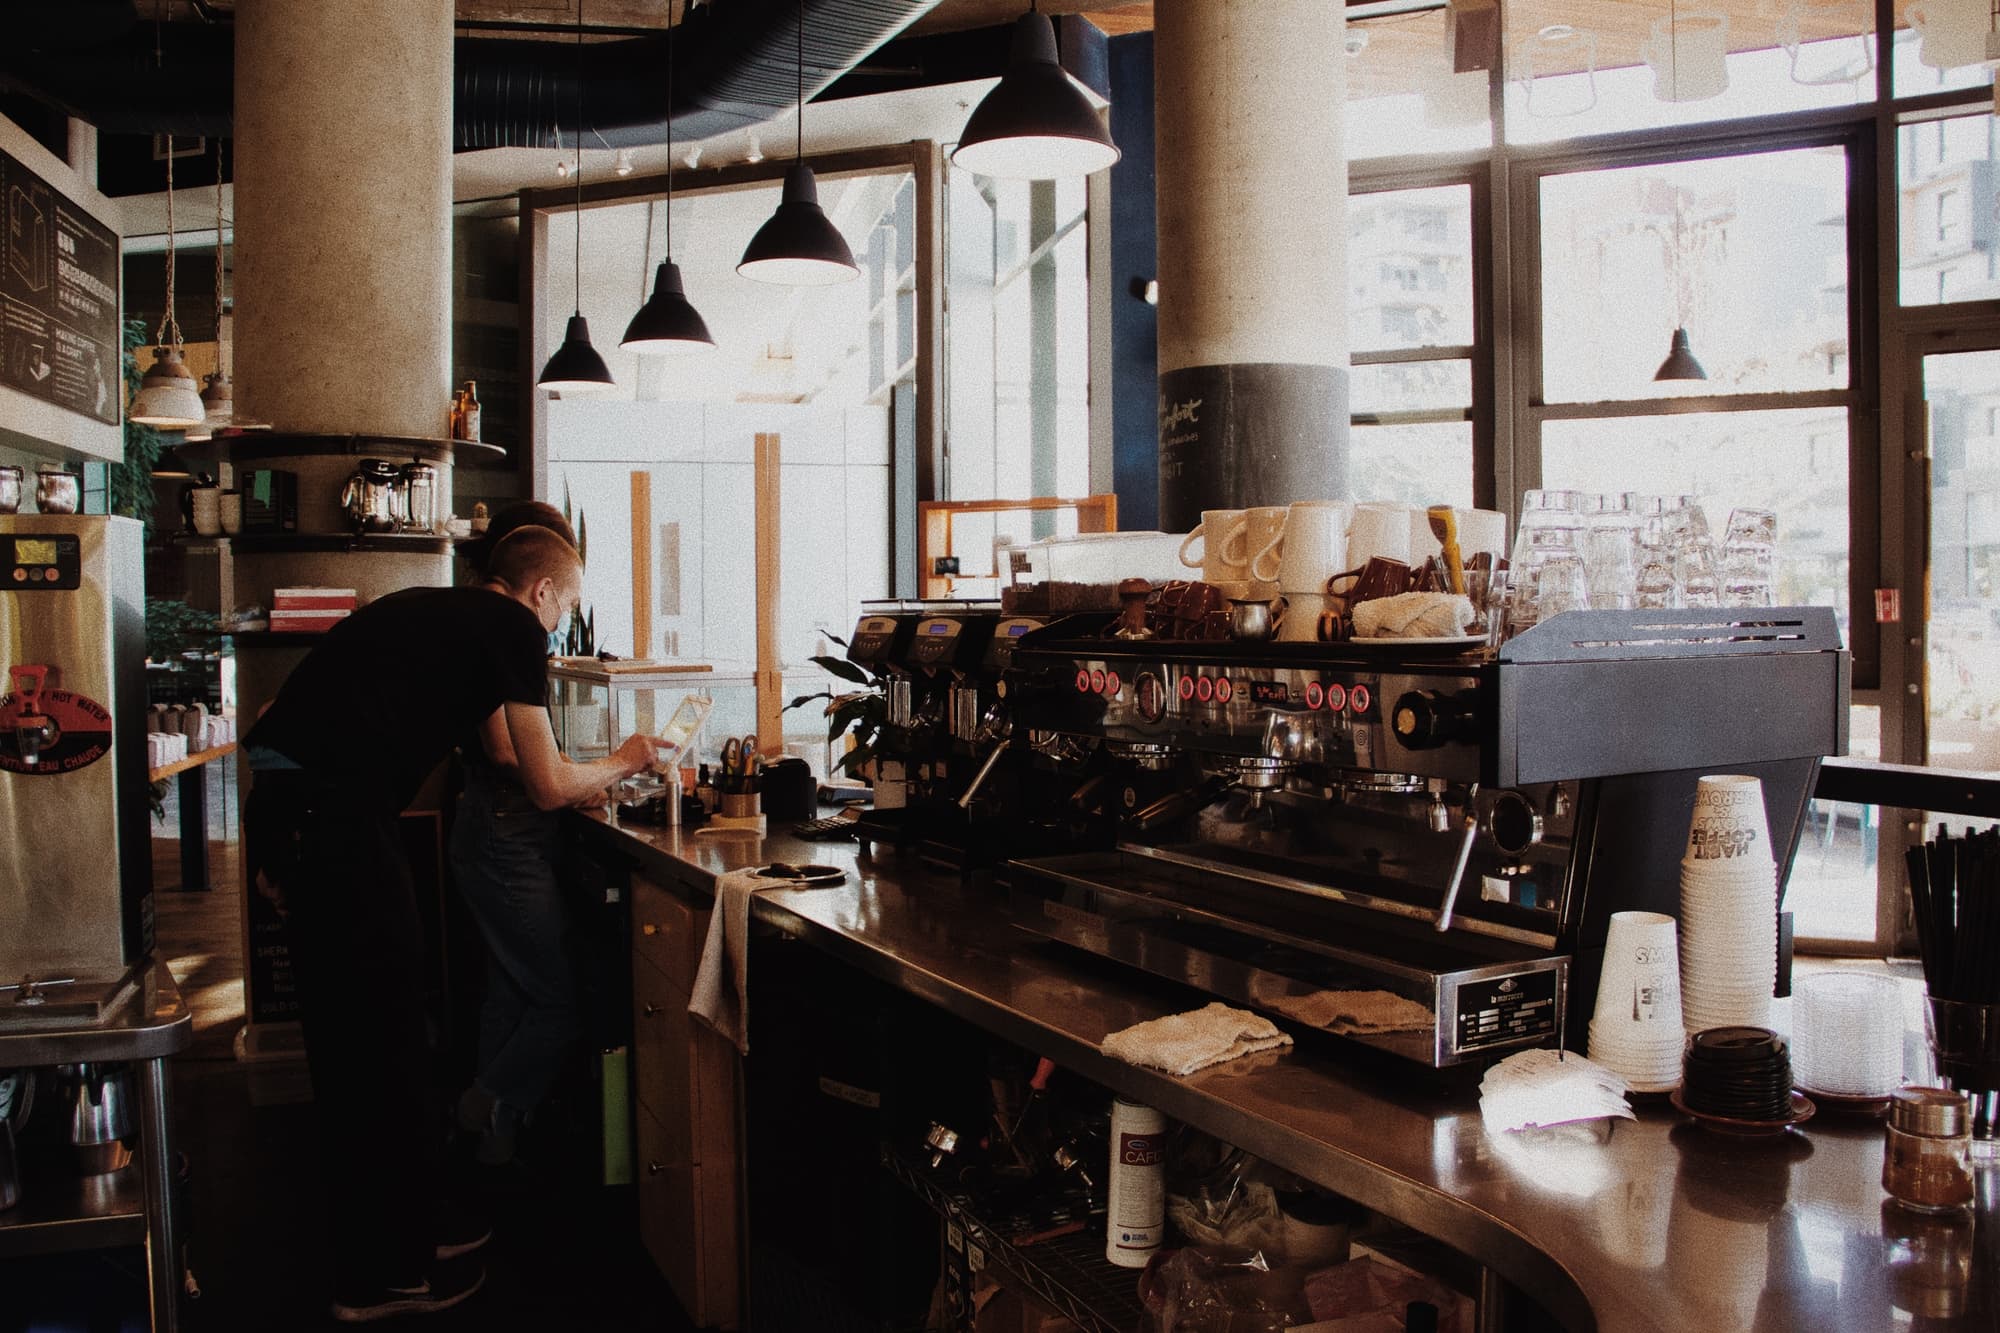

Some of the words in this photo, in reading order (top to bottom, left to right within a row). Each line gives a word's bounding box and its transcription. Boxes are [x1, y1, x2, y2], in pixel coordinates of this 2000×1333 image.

[51, 692, 72, 704] HOT
[76, 698, 109, 722] WATER
[39, 759, 60, 771] EAU
[63, 744, 103, 769] CHAUDE
[1692, 829, 1757, 846] COFFEE
